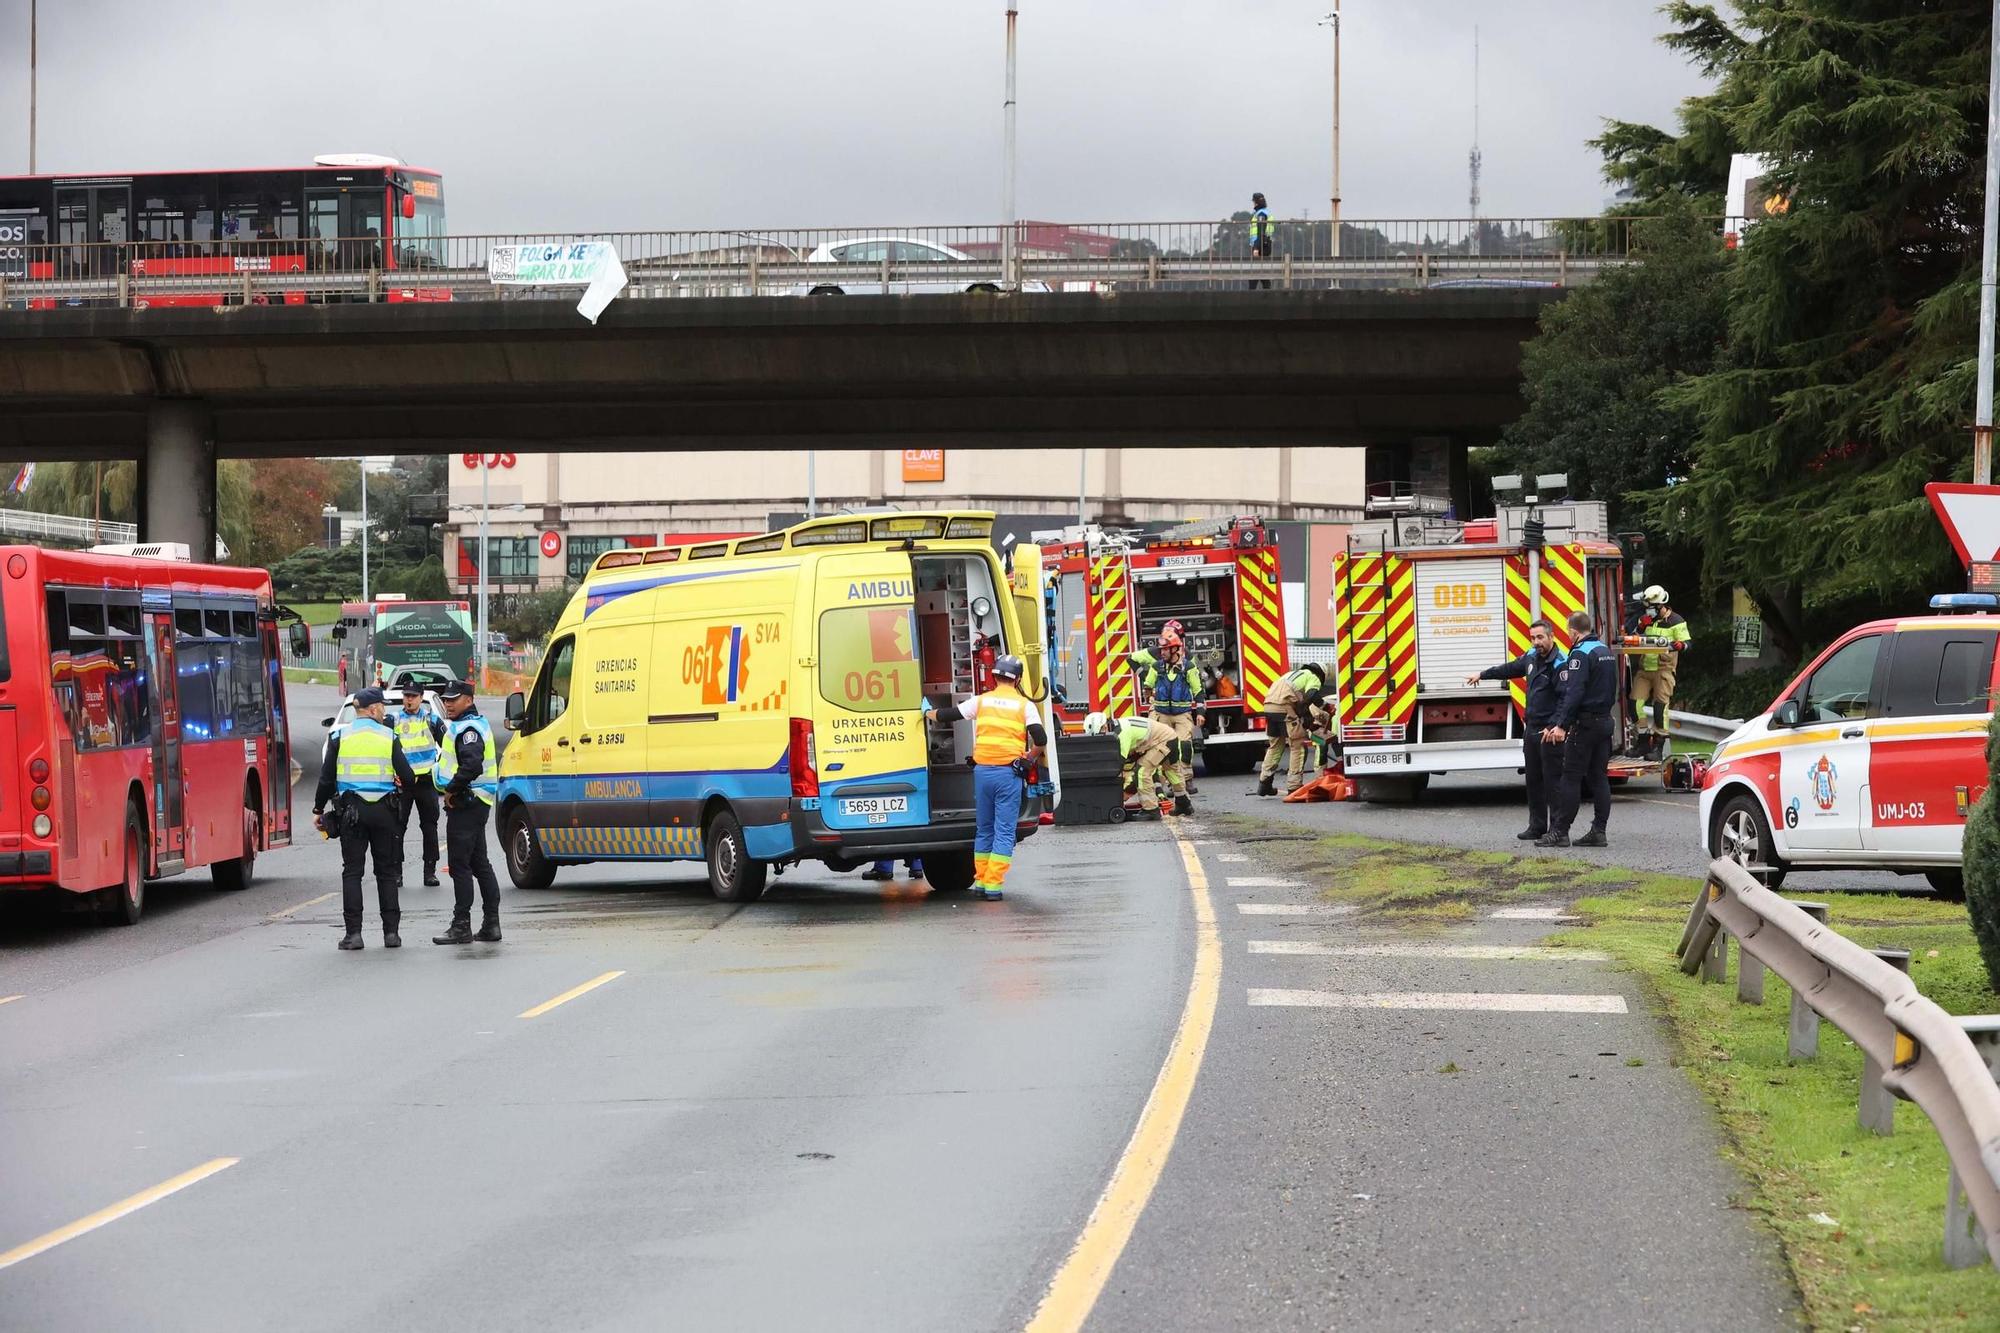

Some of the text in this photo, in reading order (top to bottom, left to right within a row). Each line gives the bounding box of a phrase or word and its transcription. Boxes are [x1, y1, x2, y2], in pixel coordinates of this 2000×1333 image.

[1166, 557, 1185, 565] 3562
[848, 580, 914, 600] AMBUL
[1433, 583, 1487, 608] 080
[1430, 614, 1492, 624] BOMBEROS
[755, 622, 780, 644] SVA
[595, 657, 638, 674] URXENCIAS
[682, 644, 715, 686] 061
[594, 678, 636, 694] SANITARIAS
[844, 668, 900, 702] 061
[832, 716, 905, 729] URXENCIAS
[834, 731, 905, 745] SANITARIAS
[584, 779, 642, 799] AMBULANCIA
[848, 798, 905, 813] 5659 LCZ
[1878, 802, 1926, 820] UMJ-03
[869, 814, 886, 824] SP
